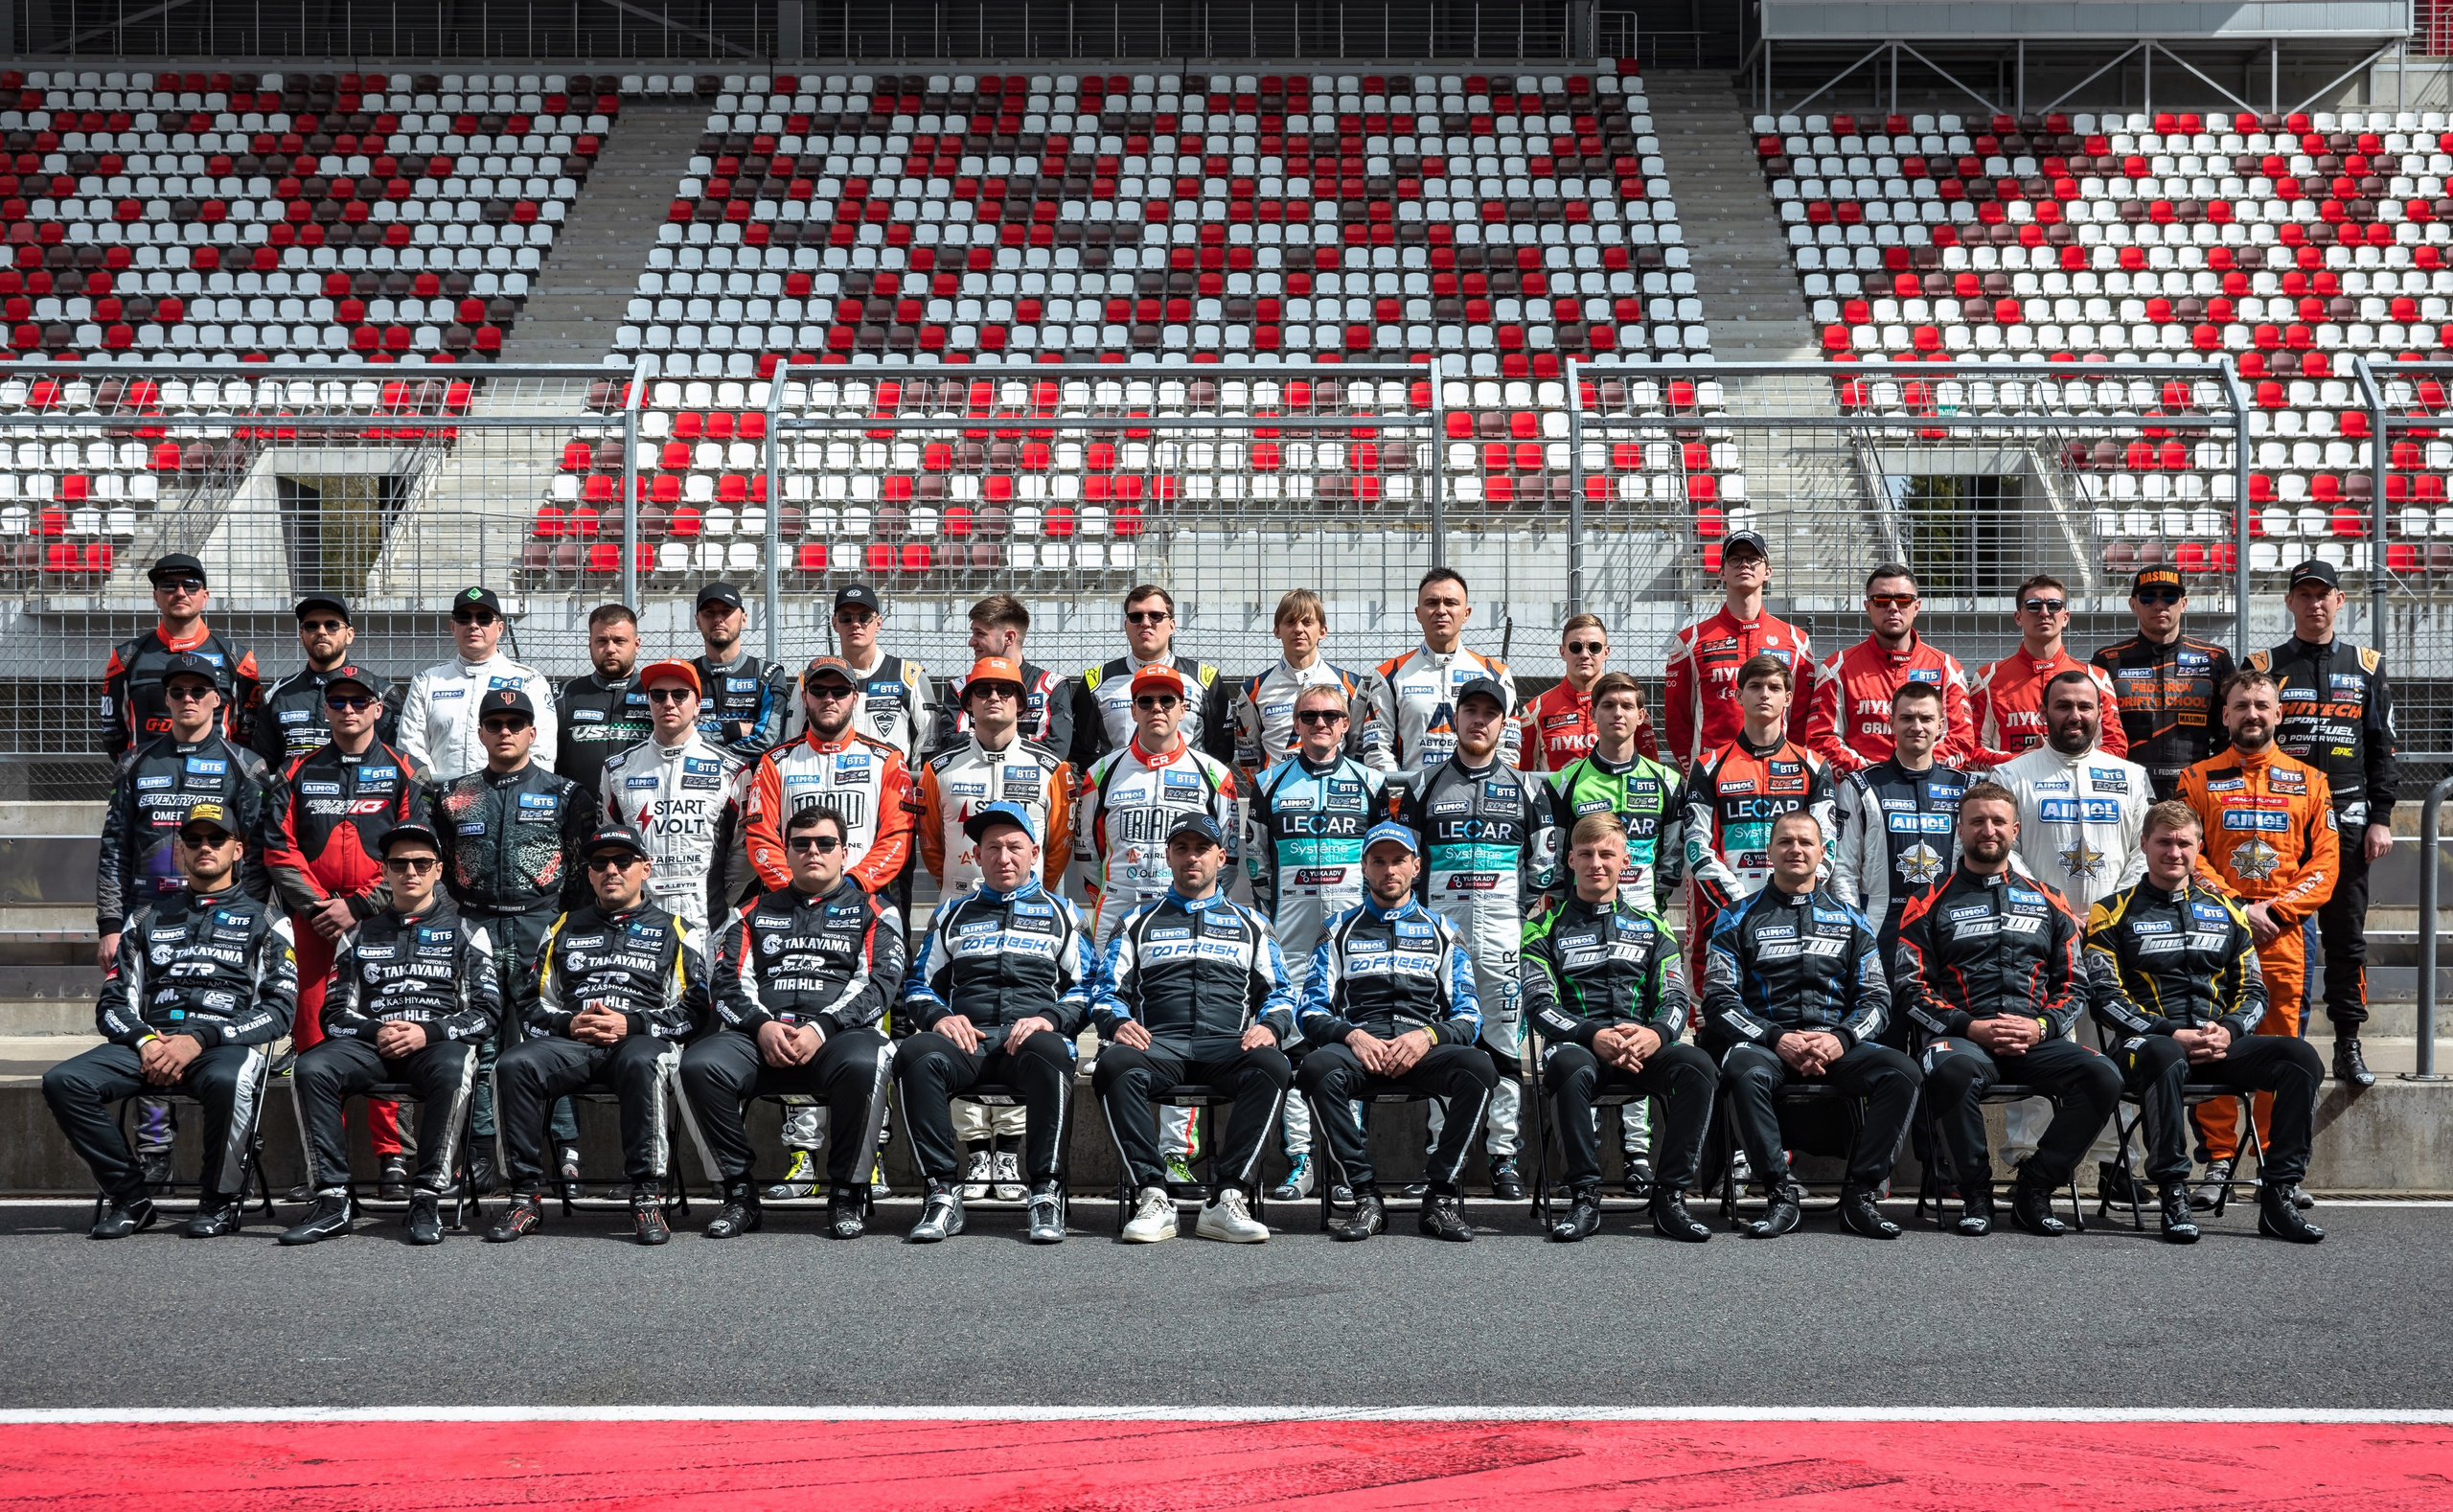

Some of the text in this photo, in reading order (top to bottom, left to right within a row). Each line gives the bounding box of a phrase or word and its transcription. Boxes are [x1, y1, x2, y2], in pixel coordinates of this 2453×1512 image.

[2139, 571, 2179, 585] MASUMA
[1146, 667, 1169, 676] CR
[1919, 671, 1937, 680] ВТБ
[2342, 676, 2363, 687] ВТБ
[2131, 682, 2194, 694] FEDOROV
[434, 690, 464, 699] AIMOL
[2282, 690, 2315, 699] AIMOL
[2333, 691, 2354, 699] RDS
[1027, 697, 1041, 705] ТБ
[2118, 697, 2209, 709] DRIFT SCHOOL
[2281, 701, 2363, 720] HITECH
[2178, 714, 2206, 725] MASUMA
[2282, 717, 2331, 725] SPORT
[2309, 724, 2355, 738] FUEL
[2289, 734, 2357, 745] POWERWHEELS
[822, 743, 841, 752] CR
[874, 746, 891, 759] OMP
[772, 747, 788, 761] OMP
[987, 753, 1006, 763] CR
[608, 756, 626, 767] OMP
[933, 757, 950, 769] OMP
[1040, 756, 1057, 768] OMP
[1150, 755, 1169, 767] CR
[199, 763, 222, 772] ВТБ
[698, 763, 718, 772] ВТБ
[1017, 769, 1037, 779] ВТБ
[2101, 770, 2123, 779] ВТБ
[139, 777, 172, 788] AIMOL
[628, 777, 658, 787] AIMOL
[1637, 782, 1656, 790] ВТБ
[2209, 780, 2244, 790] AIMOL
[2271, 782, 2294, 790] RDS
[952, 784, 985, 793] AIMOL
[1340, 783, 1359, 792] ВТБ
[139, 794, 195, 808] SEVENTY
[533, 797, 554, 807] ВТБ
[1279, 799, 1311, 808] AIMOL
[1629, 797, 1647, 806] RDS
[653, 799, 706, 815] START
[1435, 802, 1467, 812] AIMOL
[654, 819, 705, 836] VOLT
[1282, 814, 1357, 836] LECAR
[1438, 819, 1512, 840] LECAR
[600, 831, 631, 840] TAKAYAMA
[1290, 841, 1349, 856] Systême
[1445, 846, 1502, 860] Systême
[655, 855, 701, 863] AIRLINE
[879, 840, 903, 868] AIRLINE
[2299, 871, 2325, 896] RDS
[839, 905, 860, 916] ВТБ
[2204, 908, 2224, 918] ВТБ
[756, 918, 791, 928] AIMOL
[1216, 916, 1238, 926] ВТБ
[2136, 923, 2169, 932] AIMOL
[431, 931, 452, 941] ВТБ
[1152, 930, 1187, 939] AIMOL
[1620, 930, 1643, 940] RDS
[784, 936, 852, 953] TAKAYAMA
[1561, 935, 1594, 948] AIMOL
[175, 945, 243, 963] TAKAYAMA
[359, 947, 393, 957] AIMOL
[588, 954, 656, 973] TAKAYAMA
[382, 963, 452, 978] TAKAYAMA
[780, 965, 836, 975] KASHIYAMA
[177, 977, 230, 988] KASHIYAMA
[773, 978, 824, 992] MAHLE
[591, 983, 644, 997] KASHIYAMA
[1502, 951, 1521, 1025] LECAR
[386, 997, 441, 1006] KASHIYAMA
